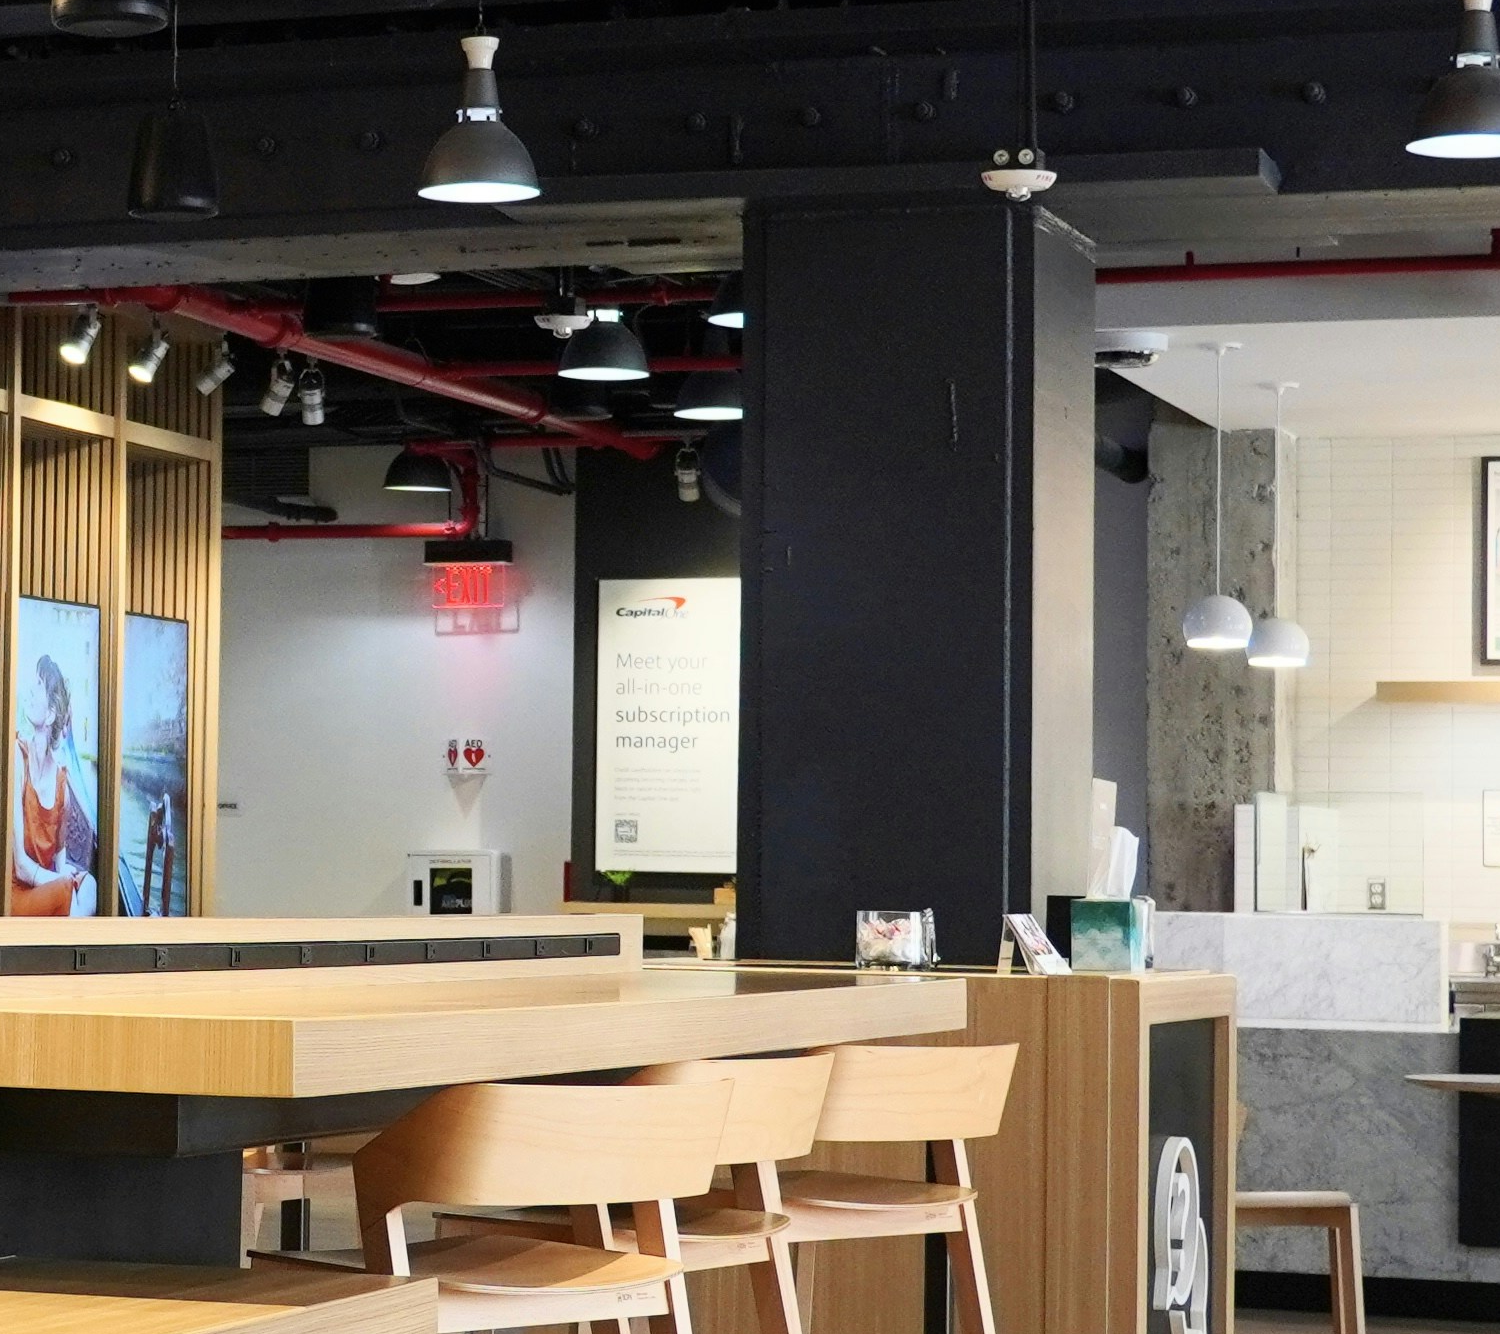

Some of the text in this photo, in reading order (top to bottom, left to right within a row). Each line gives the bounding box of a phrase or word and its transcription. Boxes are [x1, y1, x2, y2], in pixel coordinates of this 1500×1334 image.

[446, 566, 493, 605] EXIT
[616, 653, 708, 672] Meet your
[616, 677, 703, 696] all-in-one
[616, 705, 731, 727] subscription
[465, 739, 483, 748] AED
[616, 735, 699, 754] manager
